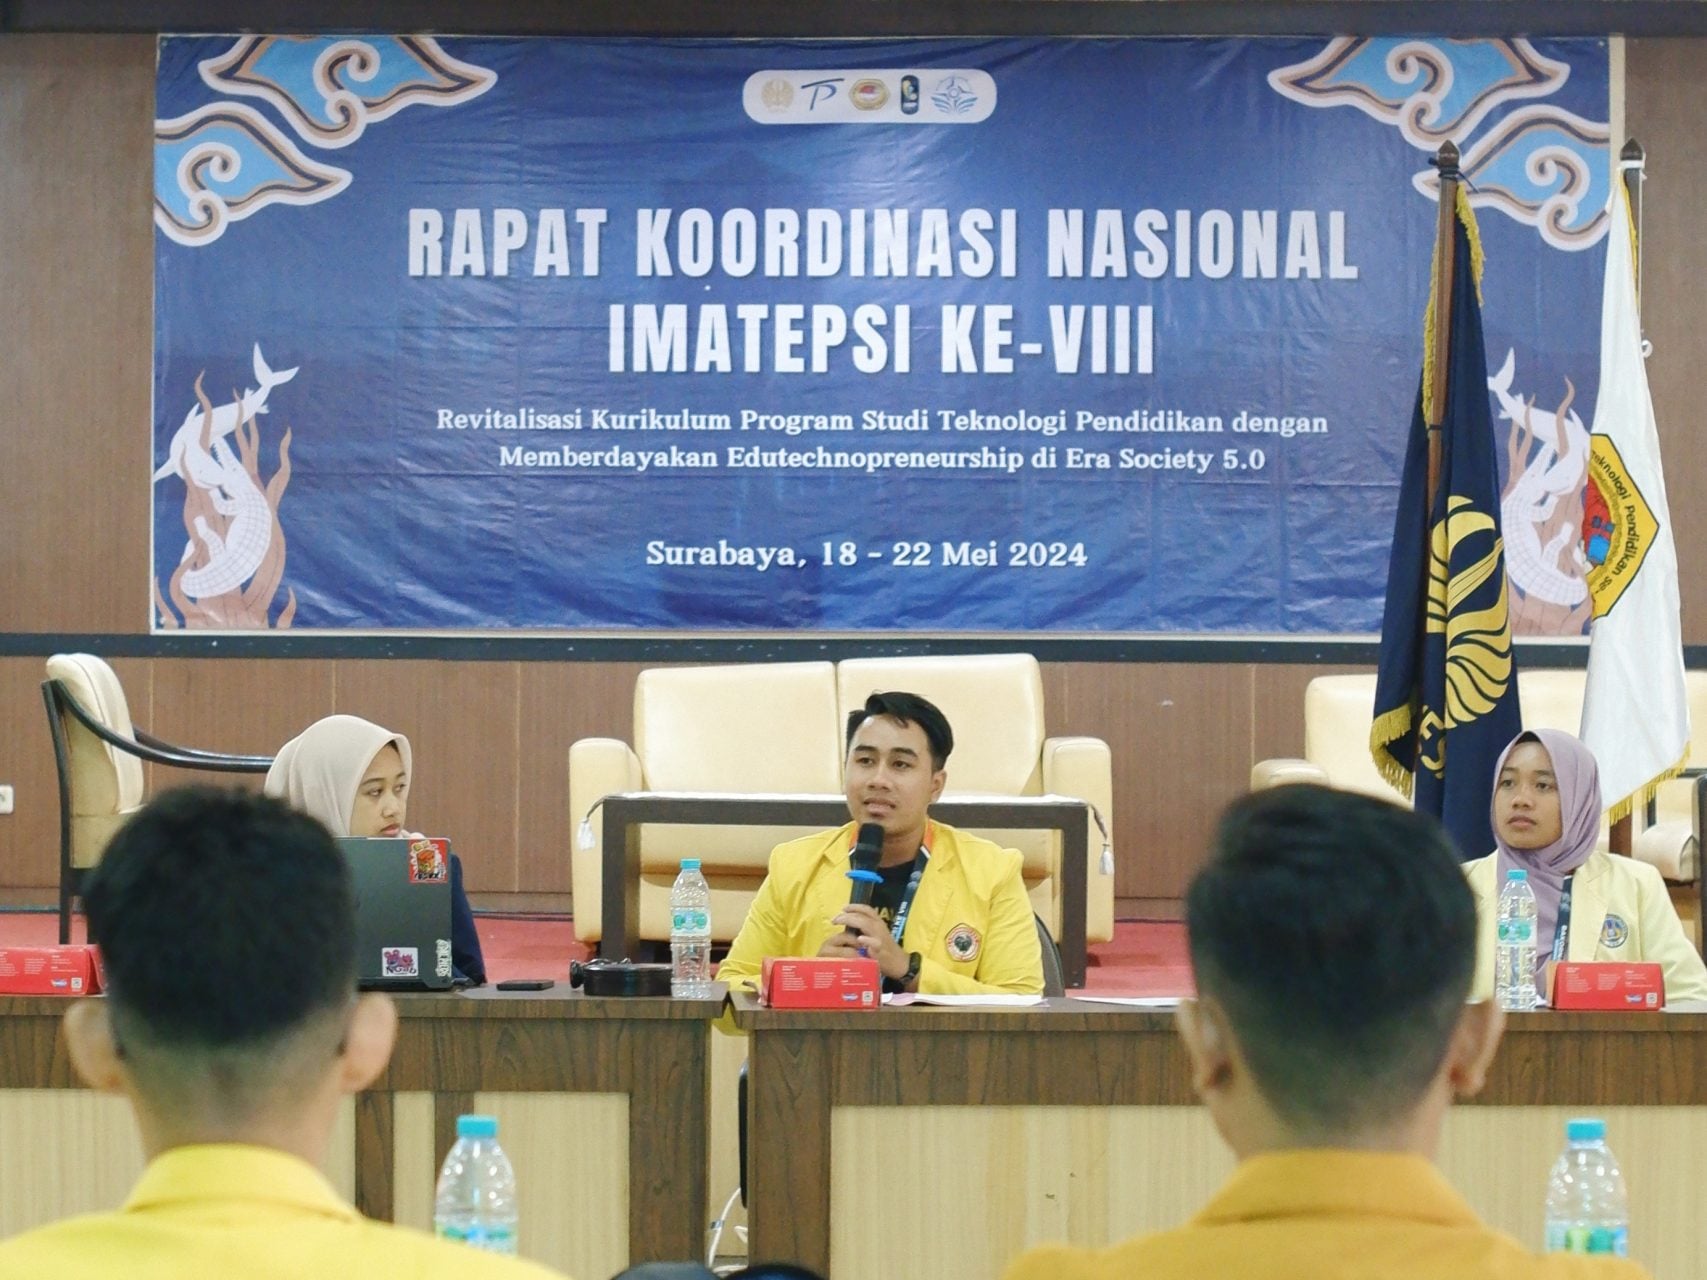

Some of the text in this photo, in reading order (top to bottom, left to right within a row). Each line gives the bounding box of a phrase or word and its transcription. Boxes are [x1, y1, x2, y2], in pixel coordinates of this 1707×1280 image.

[408, 207, 1358, 279] RAPAT KOORDINASI NASIONAL
[609, 303, 1153, 374] IMATEPSI KE-VIII
[437, 407, 1328, 437] Revitalisasi Kurikulum Program Studi Teknologi Pendidikan dengan
[499, 445, 1266, 474] Memberdayakan Edutechnopreneurship di Era Society 5.0
[646, 539, 808, 571] Surabaya,
[822, 541, 857, 566] 18
[892, 541, 931, 566] 22
[942, 540, 998, 566] Mei
[1009, 541, 1088, 567] 2024
[1611, 505, 1640, 576] Pendidikan
